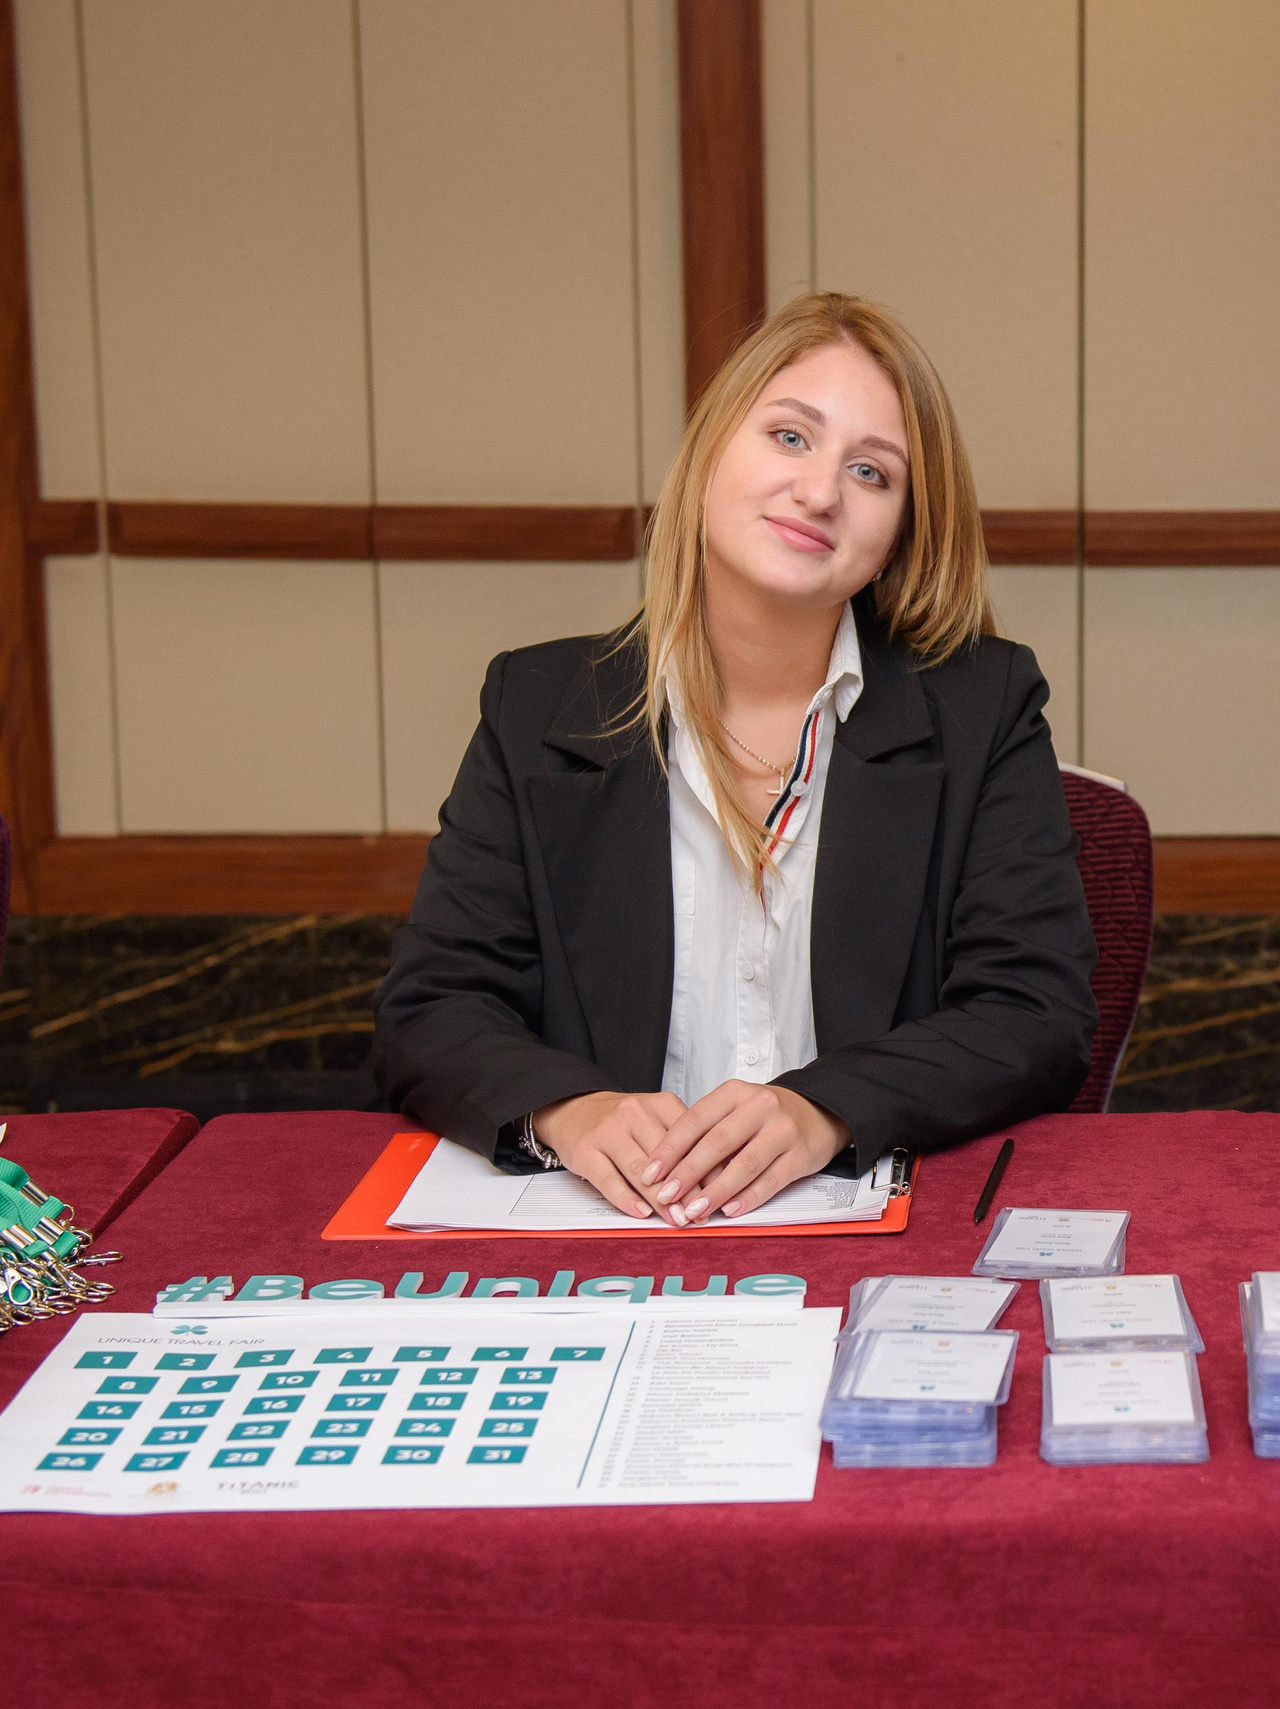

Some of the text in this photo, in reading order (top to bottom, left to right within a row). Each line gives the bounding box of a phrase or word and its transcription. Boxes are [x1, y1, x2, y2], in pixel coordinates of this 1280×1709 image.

[97, 1336, 265, 1346] UNIQUE TRAVEL FAIR
[102, 1349, 588, 1367] 1 2 3 4 5 6 7
[118, 1370, 543, 1391] 8 9 10 11 12 13
[96, 1395, 534, 1416] 14 15 16 17 18 19
[70, 1421, 525, 1443] 20 21 22 23 24 25
[51, 1449, 512, 1469] 26 27 28 29 30 31
